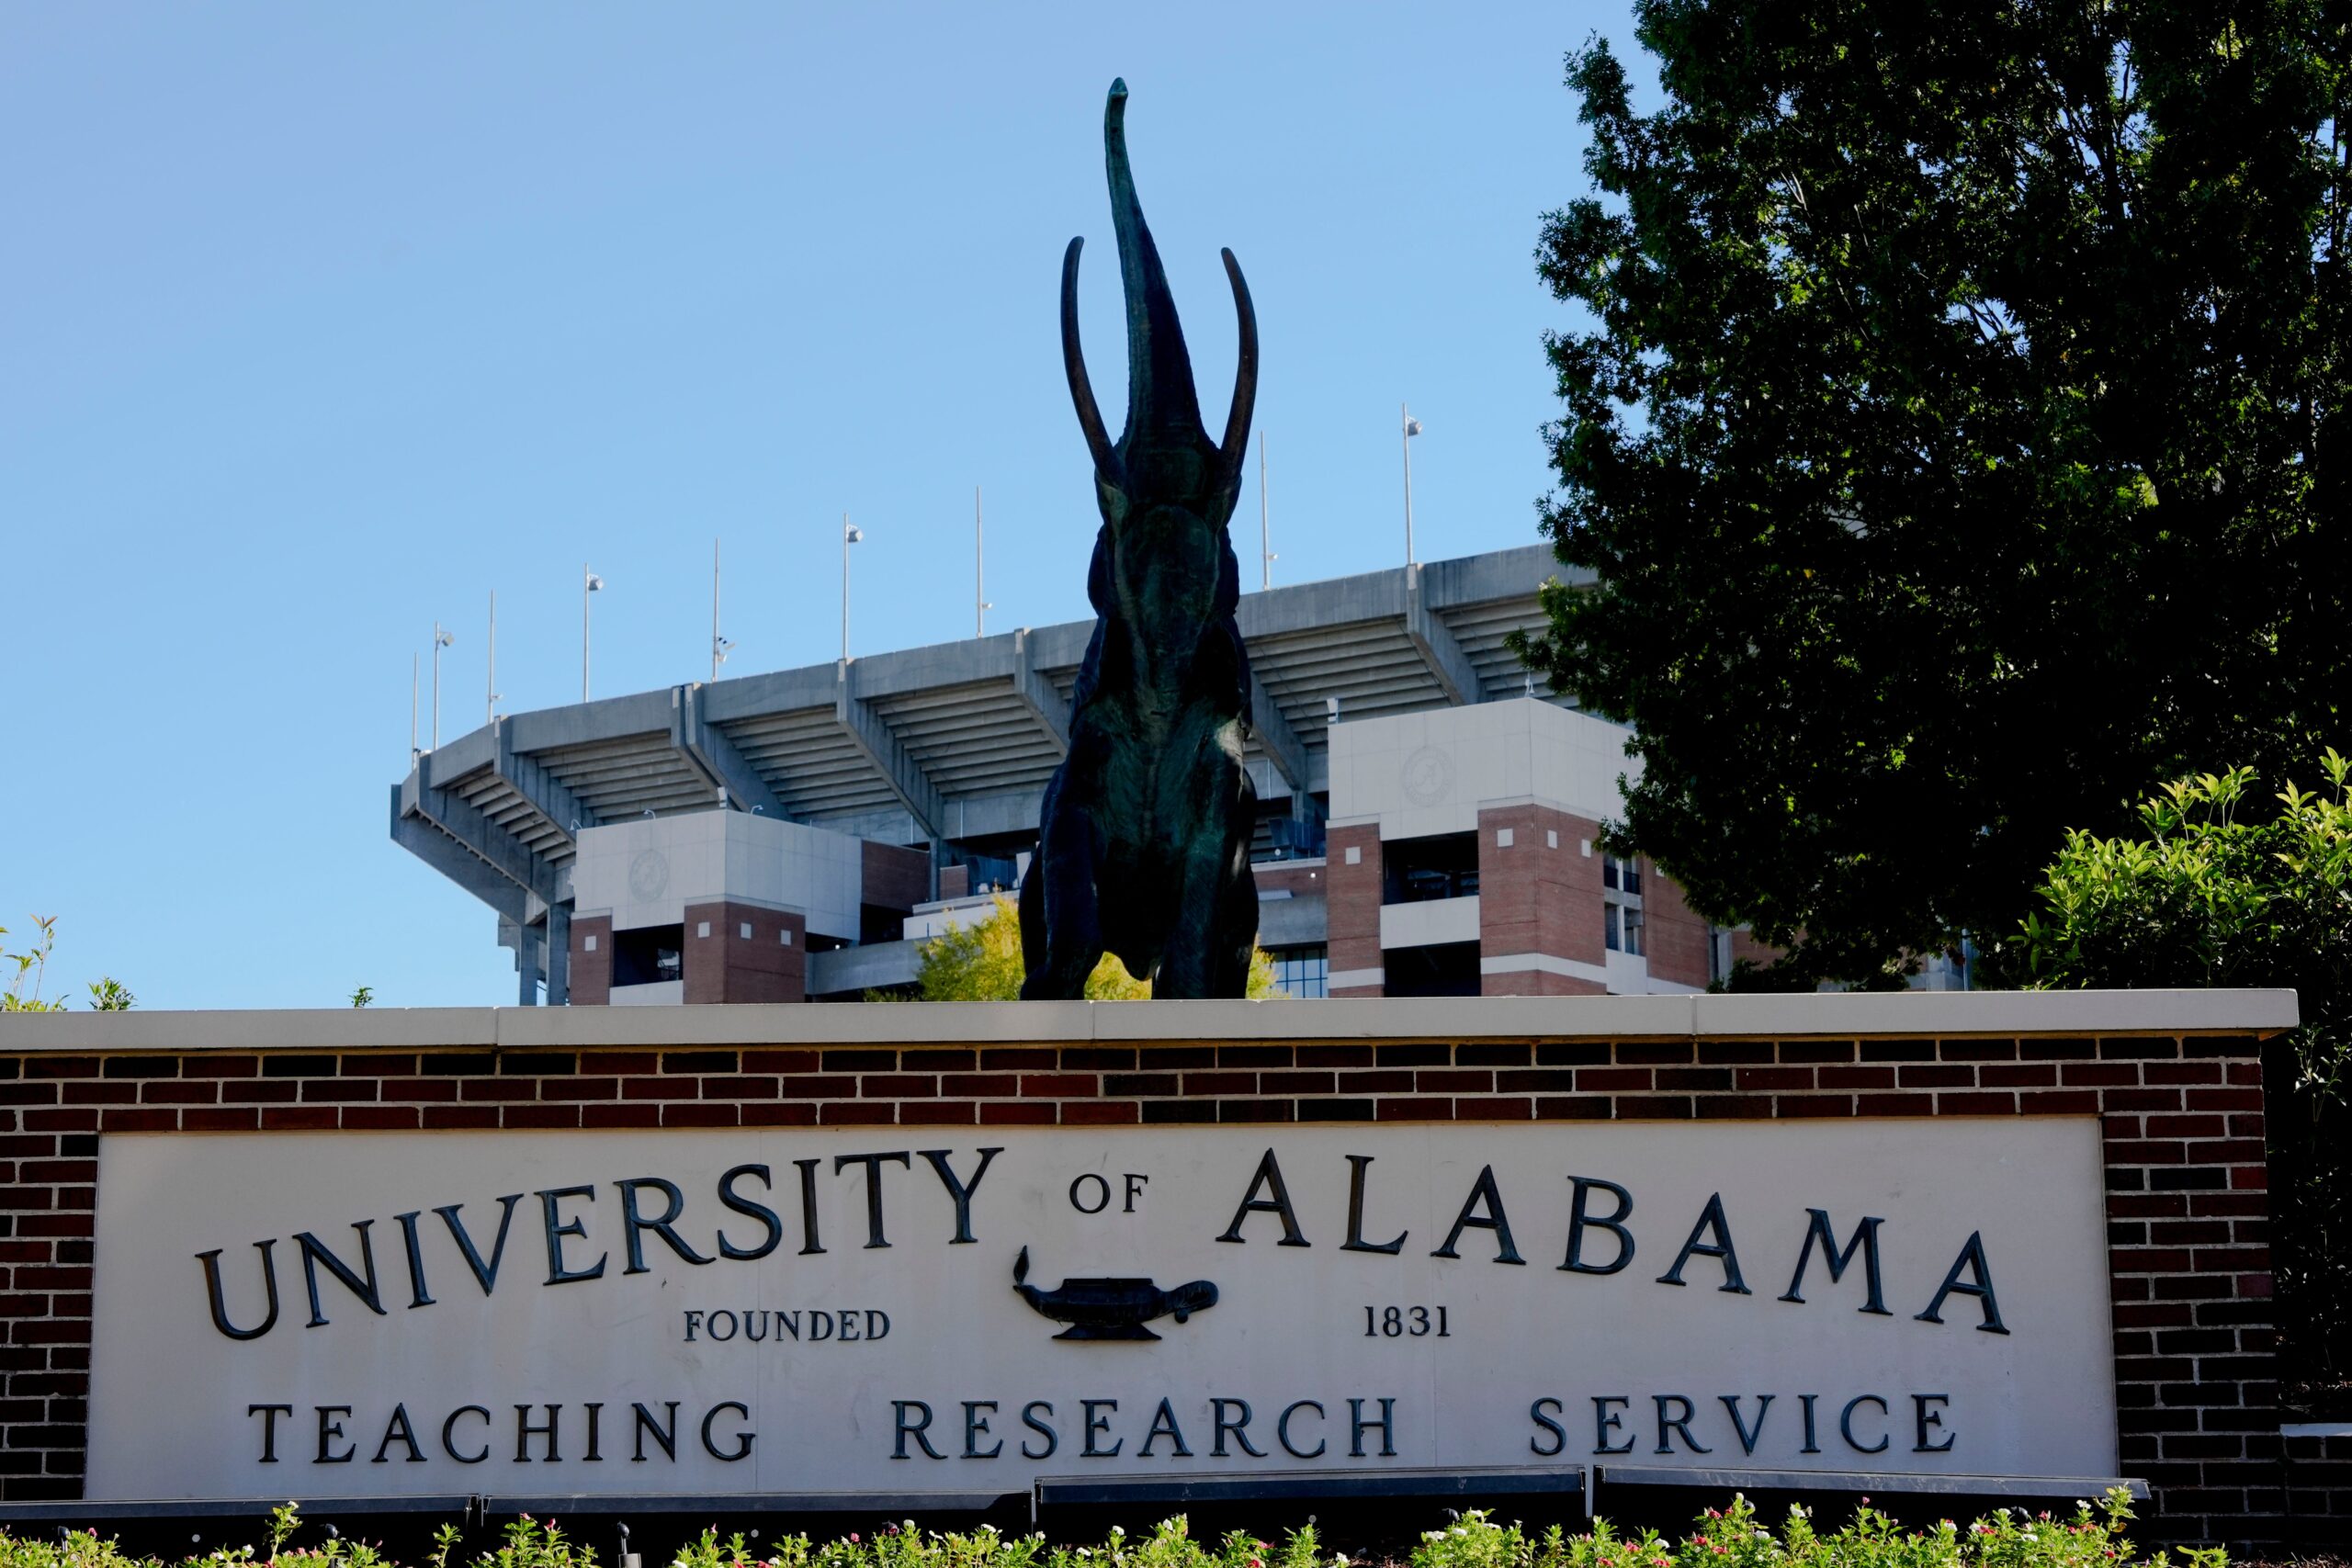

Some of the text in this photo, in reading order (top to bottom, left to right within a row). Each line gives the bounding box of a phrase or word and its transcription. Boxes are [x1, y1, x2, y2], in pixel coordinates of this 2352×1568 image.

[194, 1146, 2011, 1342] UNIVERSITY OF ALABAMA
[683, 1305, 1452, 1343] FOUNDED 1831
[247, 1393, 1957, 1467] TEACHING RESEARCH SERVICE
